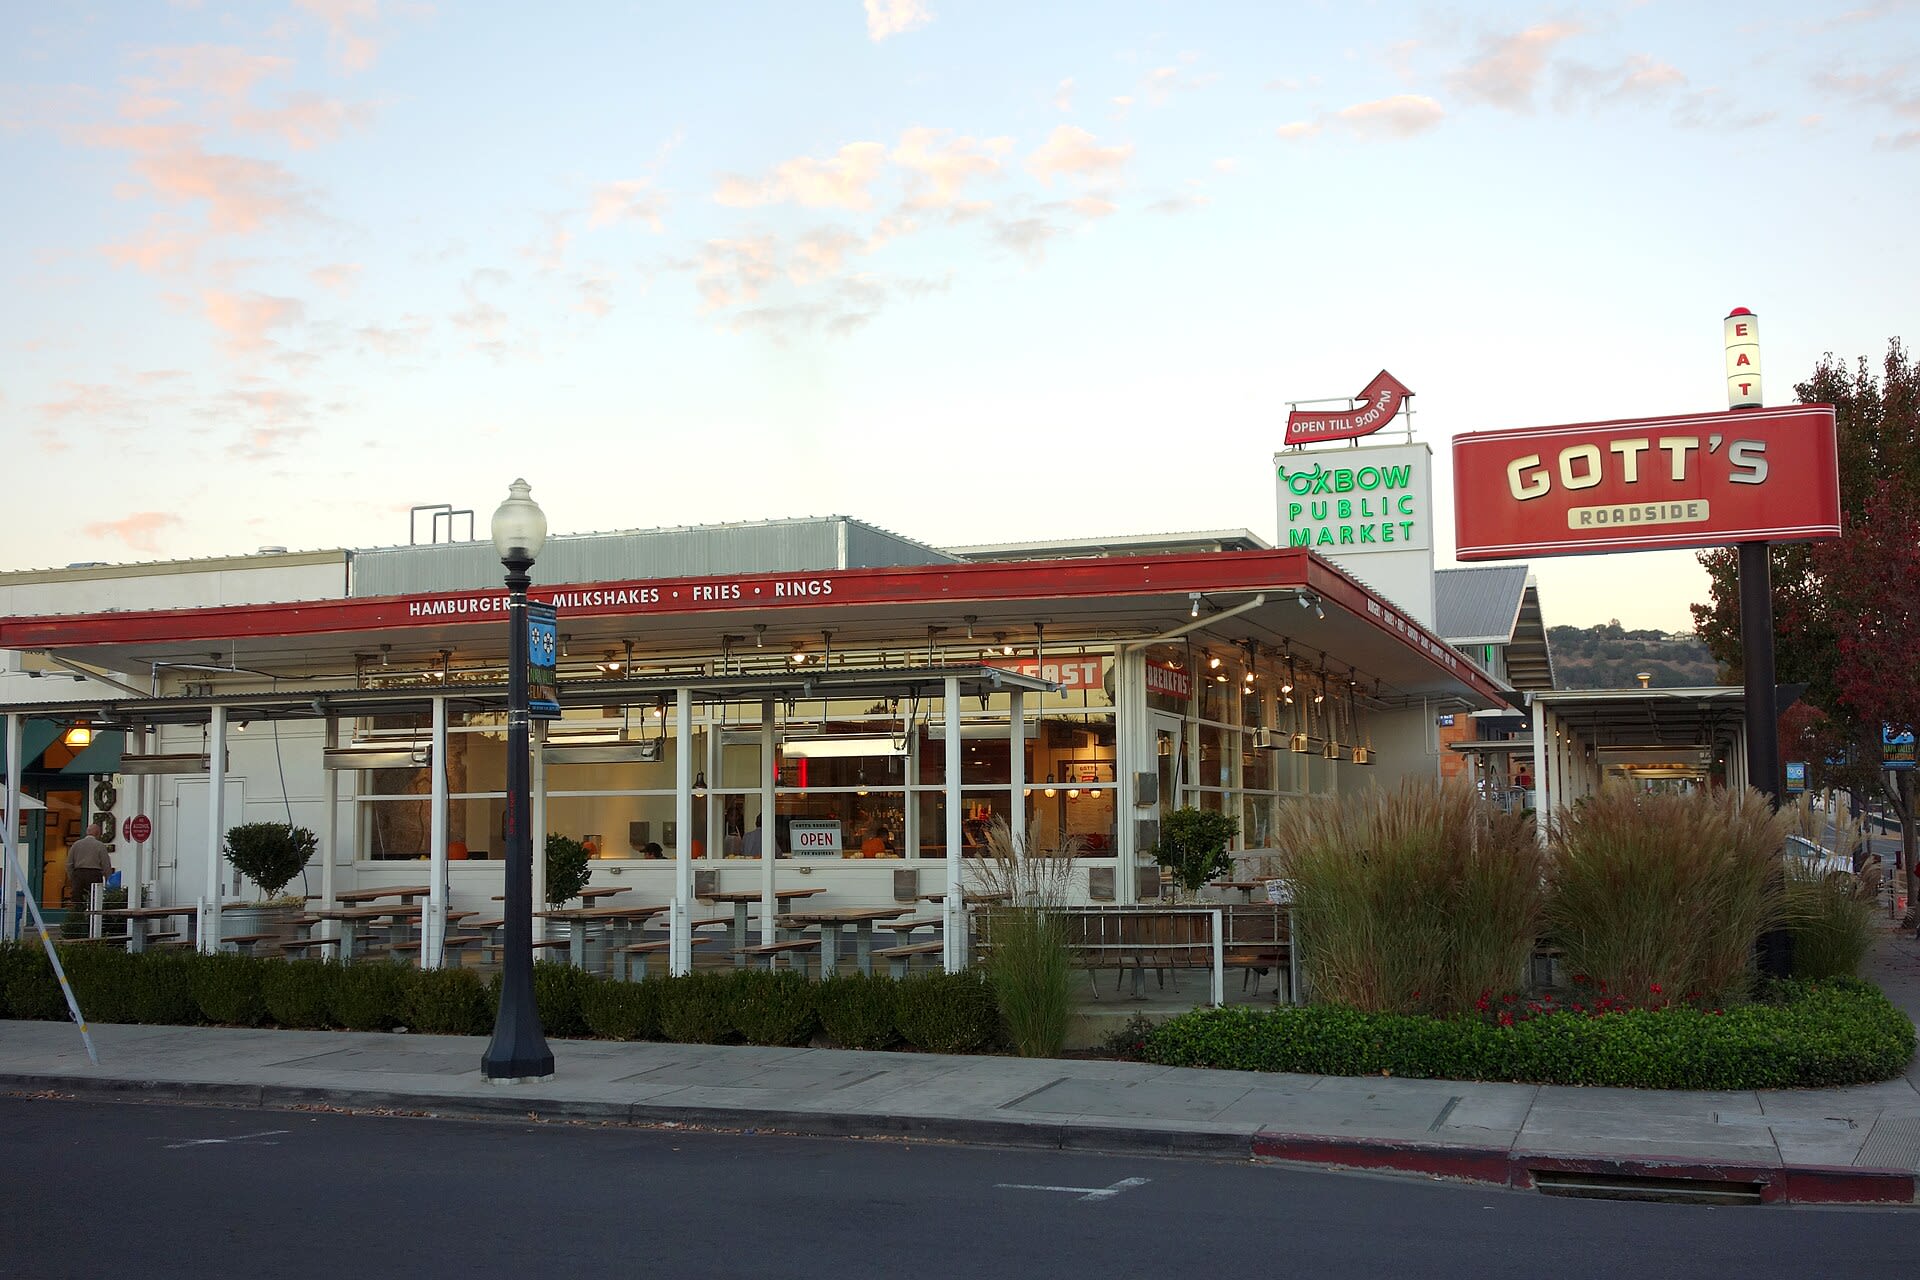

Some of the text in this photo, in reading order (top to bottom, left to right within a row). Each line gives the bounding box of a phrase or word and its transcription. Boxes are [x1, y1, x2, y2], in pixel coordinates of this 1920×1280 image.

[1735, 323, 1752, 396] EAT
[1292, 390, 1392, 433] OPEN TILL 9:00 PM
[1278, 463, 1412, 495] OXBOW
[1506, 433, 1769, 501] GOTT'S
[1289, 495, 1414, 521] PUBLIC
[1580, 503, 1699, 525] ROADSIDE
[1289, 521, 1414, 547] MARKET
[409, 597, 511, 616] HAMBURGER
[552, 588, 660, 608] MILKSHAKES
[693, 584, 741, 601] FRIES
[775, 579, 833, 597] RINGS
[800, 832, 833, 846] OPEN
